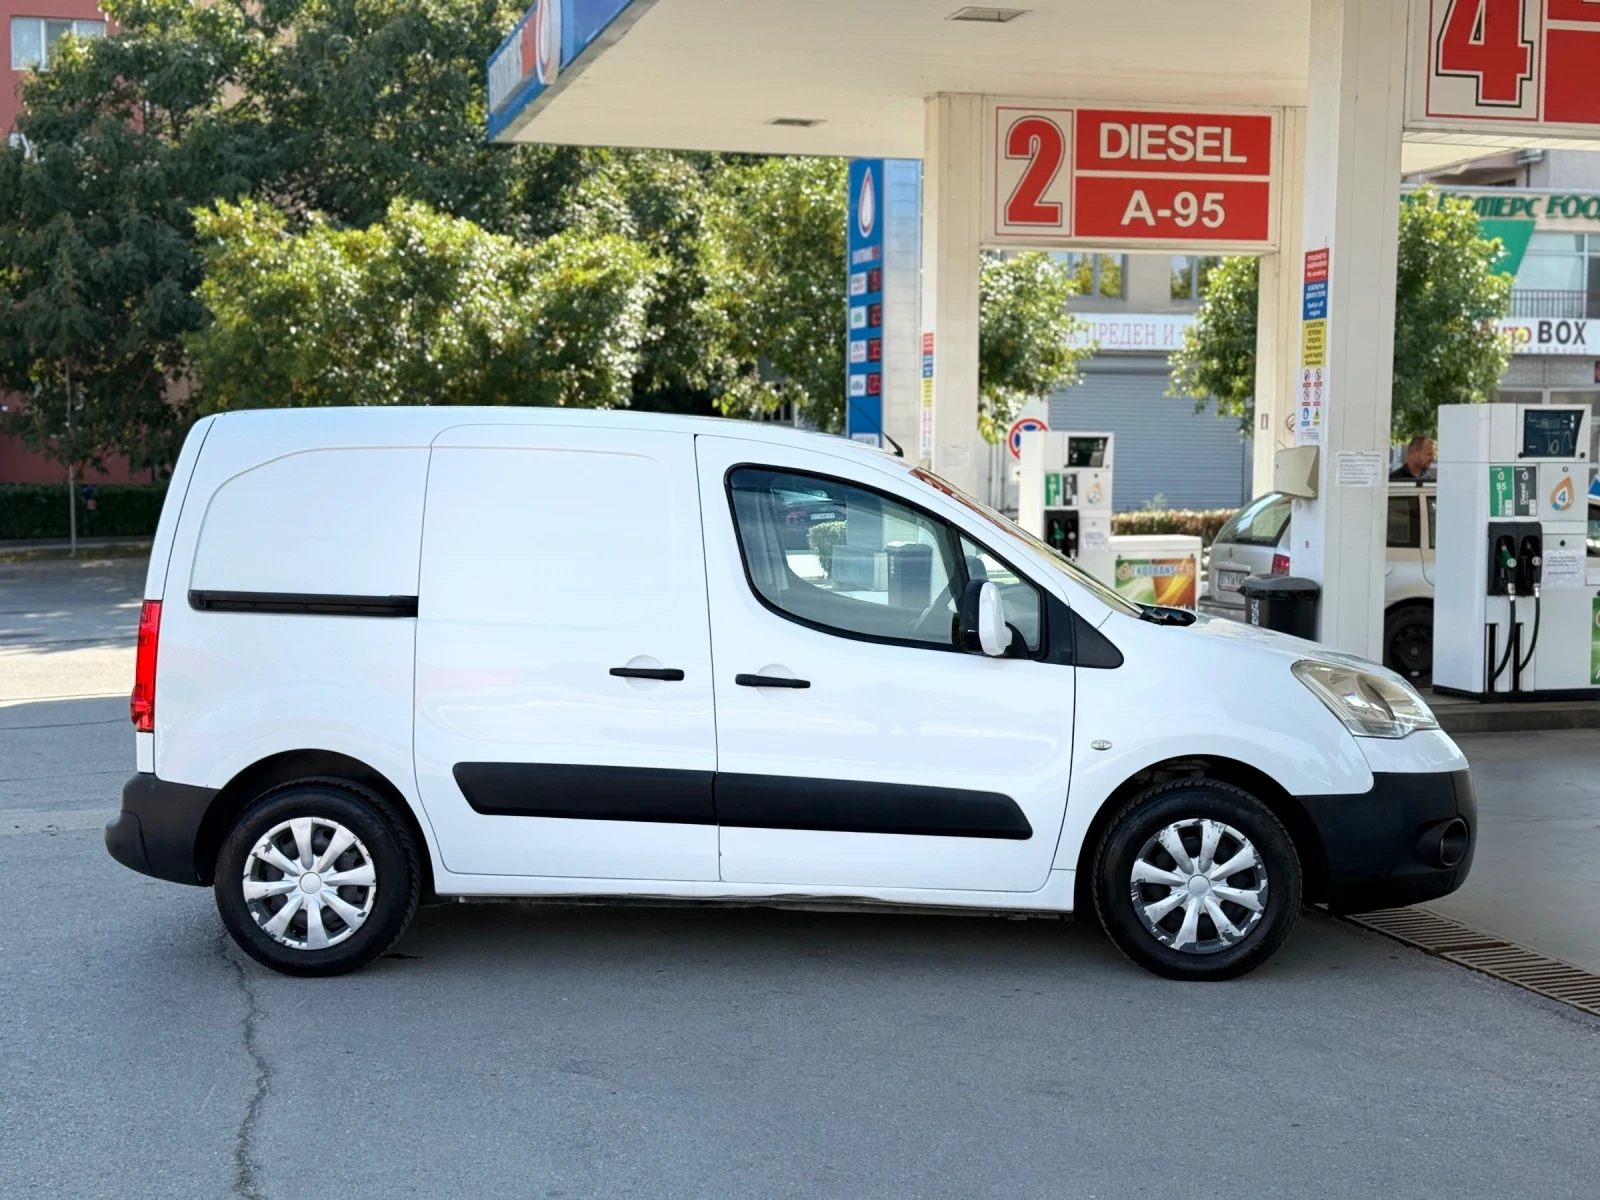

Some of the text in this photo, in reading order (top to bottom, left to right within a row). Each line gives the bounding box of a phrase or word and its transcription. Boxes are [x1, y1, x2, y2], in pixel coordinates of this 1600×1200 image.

[1435, 0, 1534, 108] 4
[1100, 122, 1248, 163] DIESEL
[1005, 115, 1066, 228] 2
[1120, 189, 1226, 229] A-95
[1538, 320, 1587, 345] BOX
[1496, 482, 1507, 491] 95
[1558, 490, 1567, 503] 4
